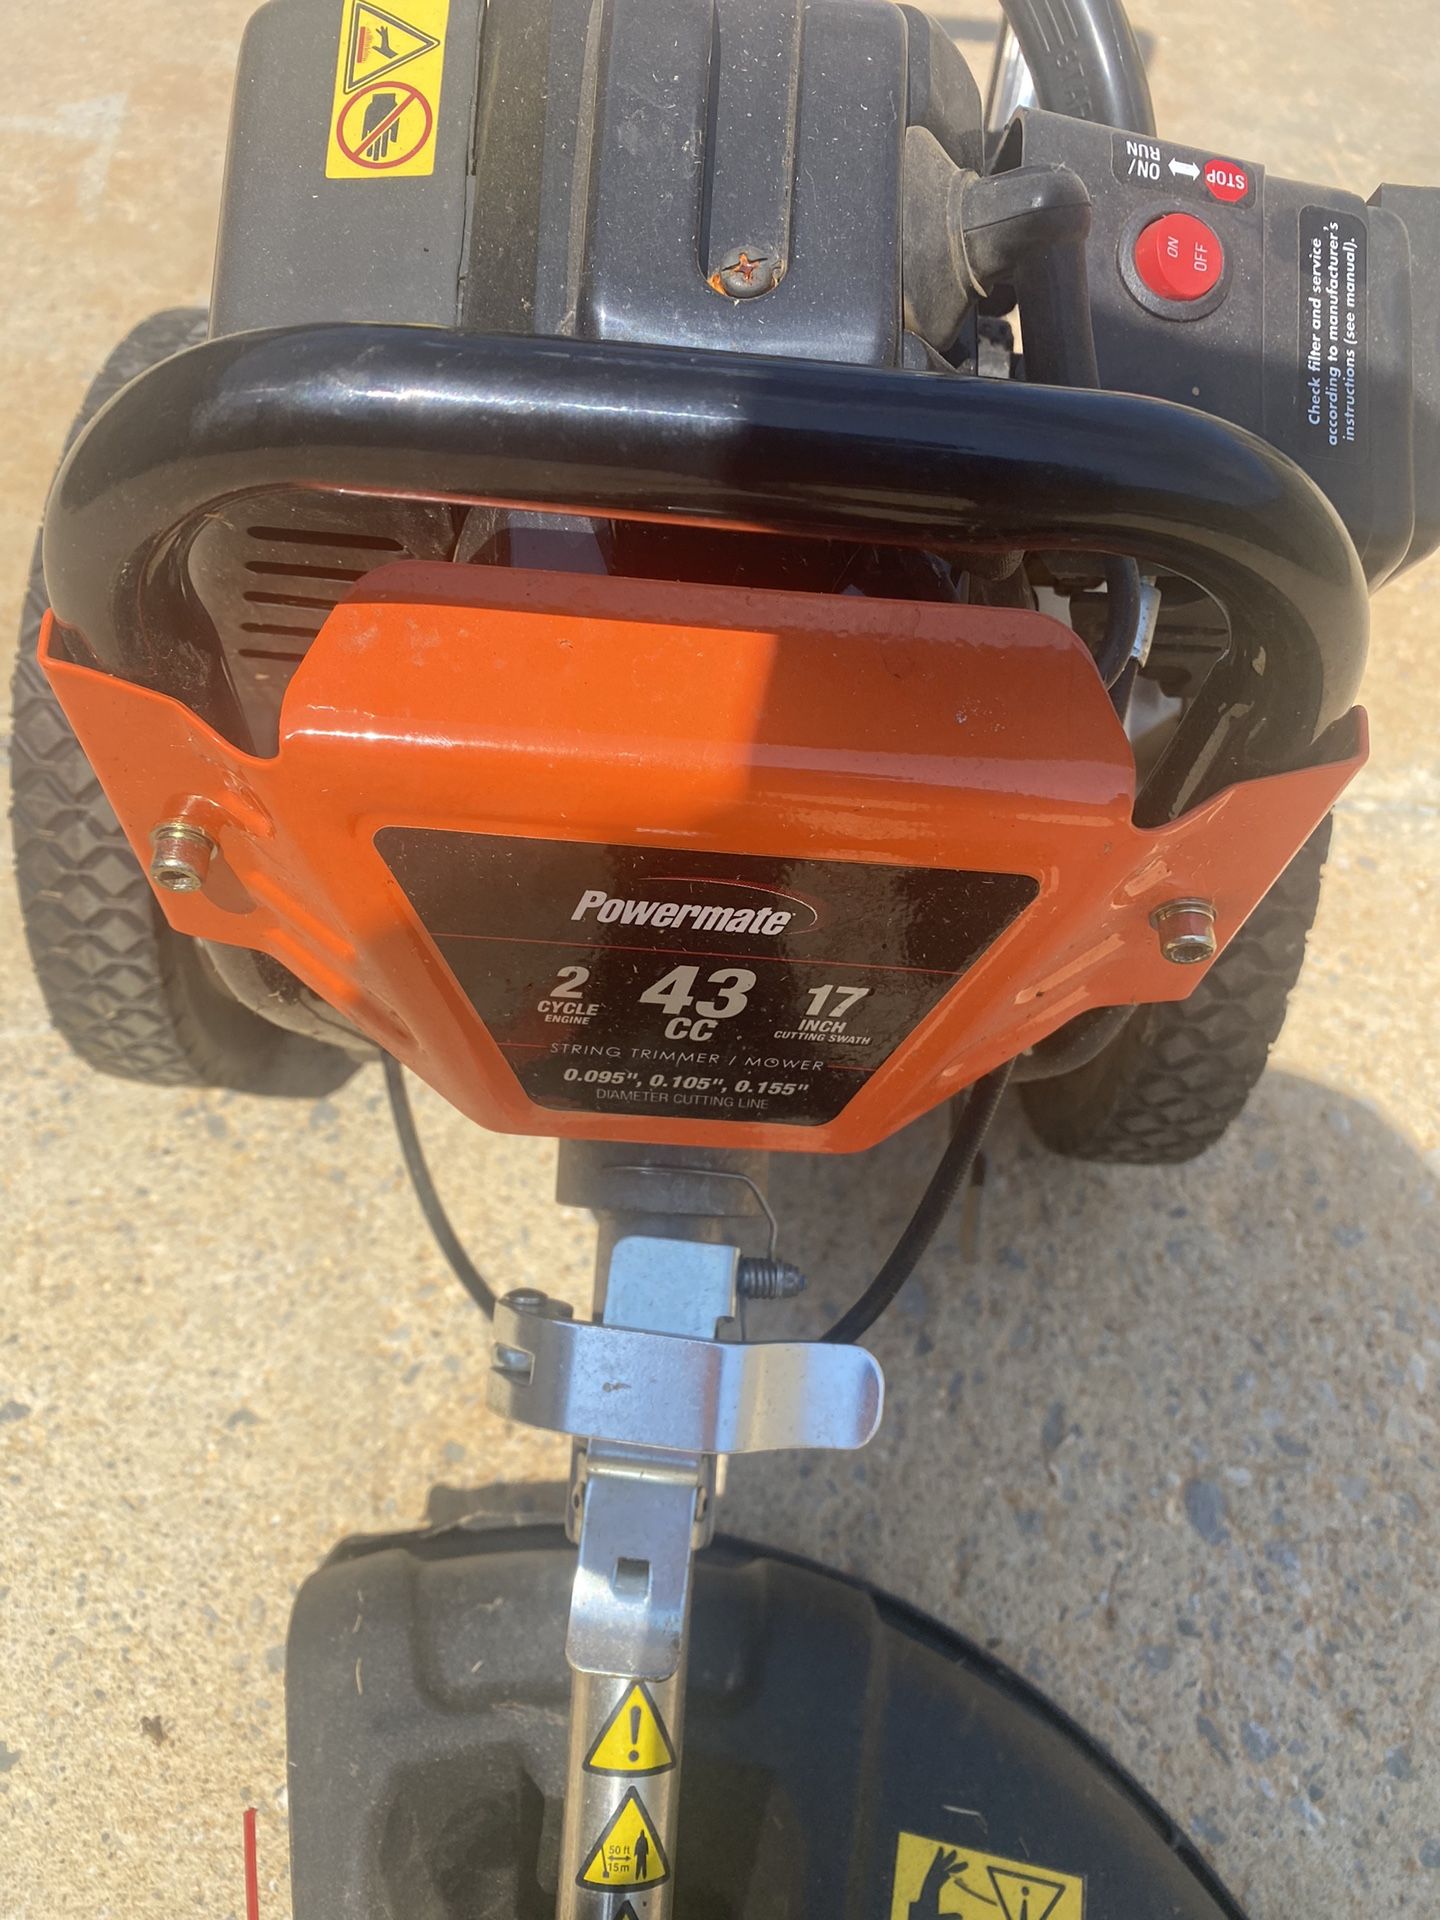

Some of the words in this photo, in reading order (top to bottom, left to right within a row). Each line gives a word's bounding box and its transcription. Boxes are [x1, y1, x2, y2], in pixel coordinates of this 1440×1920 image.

[1126, 140, 1160, 161] RUN
[1128, 158, 1160, 180] ON/
[1206, 169, 1245, 190] STOP
[1167, 236, 1179, 258] ON
[1194, 242, 1208, 272] OFF
[1309, 238, 1321, 294] service
[1342, 238, 1358, 308] manual).
[1323, 221, 1339, 341] manufacturer's
[1308, 297, 1321, 330] and
[1343, 312, 1358, 345] (see
[1308, 334, 1321, 372] filter
[1327, 345, 1338, 362] to
[1308, 377, 1321, 425] Check
[1325, 366, 1341, 446] according
[1342, 349, 1355, 441] instructions
[570, 889, 794, 936] Powermate
[550, 965, 590, 999] 2
[638, 964, 757, 1019] 43
[537, 1000, 600, 1017] CYCLE
[805, 984, 870, 1018] 17
[544, 1014, 591, 1025] ENGINE
[664, 1017, 719, 1042] CC
[797, 1019, 847, 1033] INCH
[773, 1030, 827, 1042] CUTTING
[828, 1034, 872, 1045] SWATH
[550, 1042, 622, 1058] STRING
[631, 1047, 720, 1064] TRIMMER
[728, 1055, 737, 1066] /
[744, 1056, 824, 1071] MOWER
[563, 1067, 642, 1088] 0.095",
[649, 1074, 728, 1094] 0.105",
[734, 1079, 810, 1095] 0.155"
[596, 1088, 669, 1102] DIAMETER
[673, 1093, 734, 1108] CUTTING
[738, 1097, 769, 1109] LINE
[609, 1845, 621, 1855] 50
[623, 1845, 630, 1855] ft
